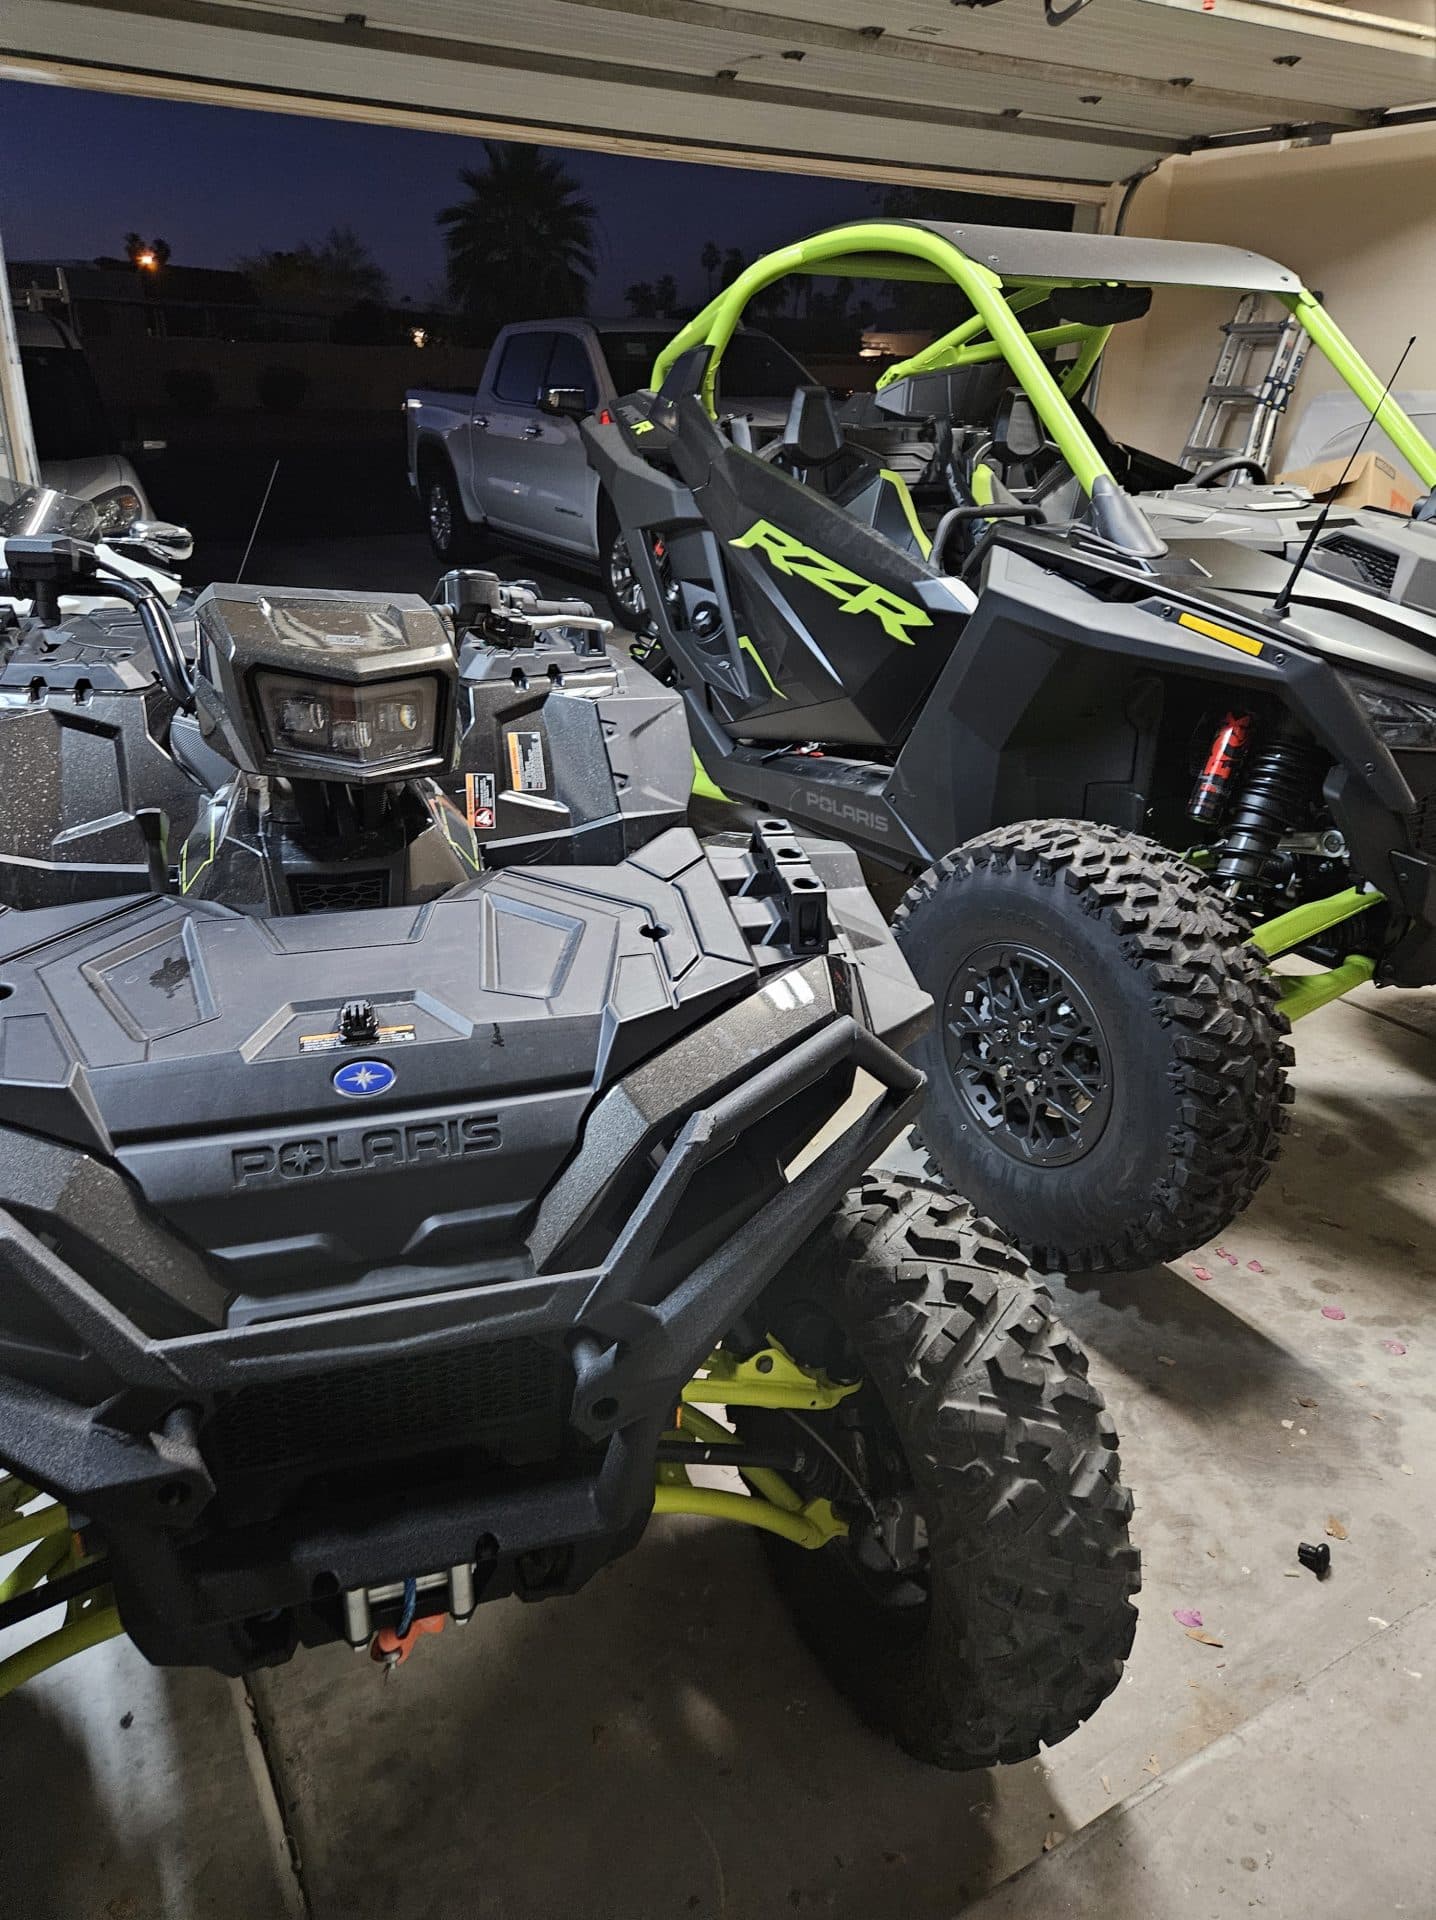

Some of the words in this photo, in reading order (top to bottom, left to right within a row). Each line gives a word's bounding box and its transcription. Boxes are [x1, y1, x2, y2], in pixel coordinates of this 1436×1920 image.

[727, 518, 934, 646] RZR
[805, 790, 889, 833] POLARIS
[231, 1113, 504, 1189] POLARIS
